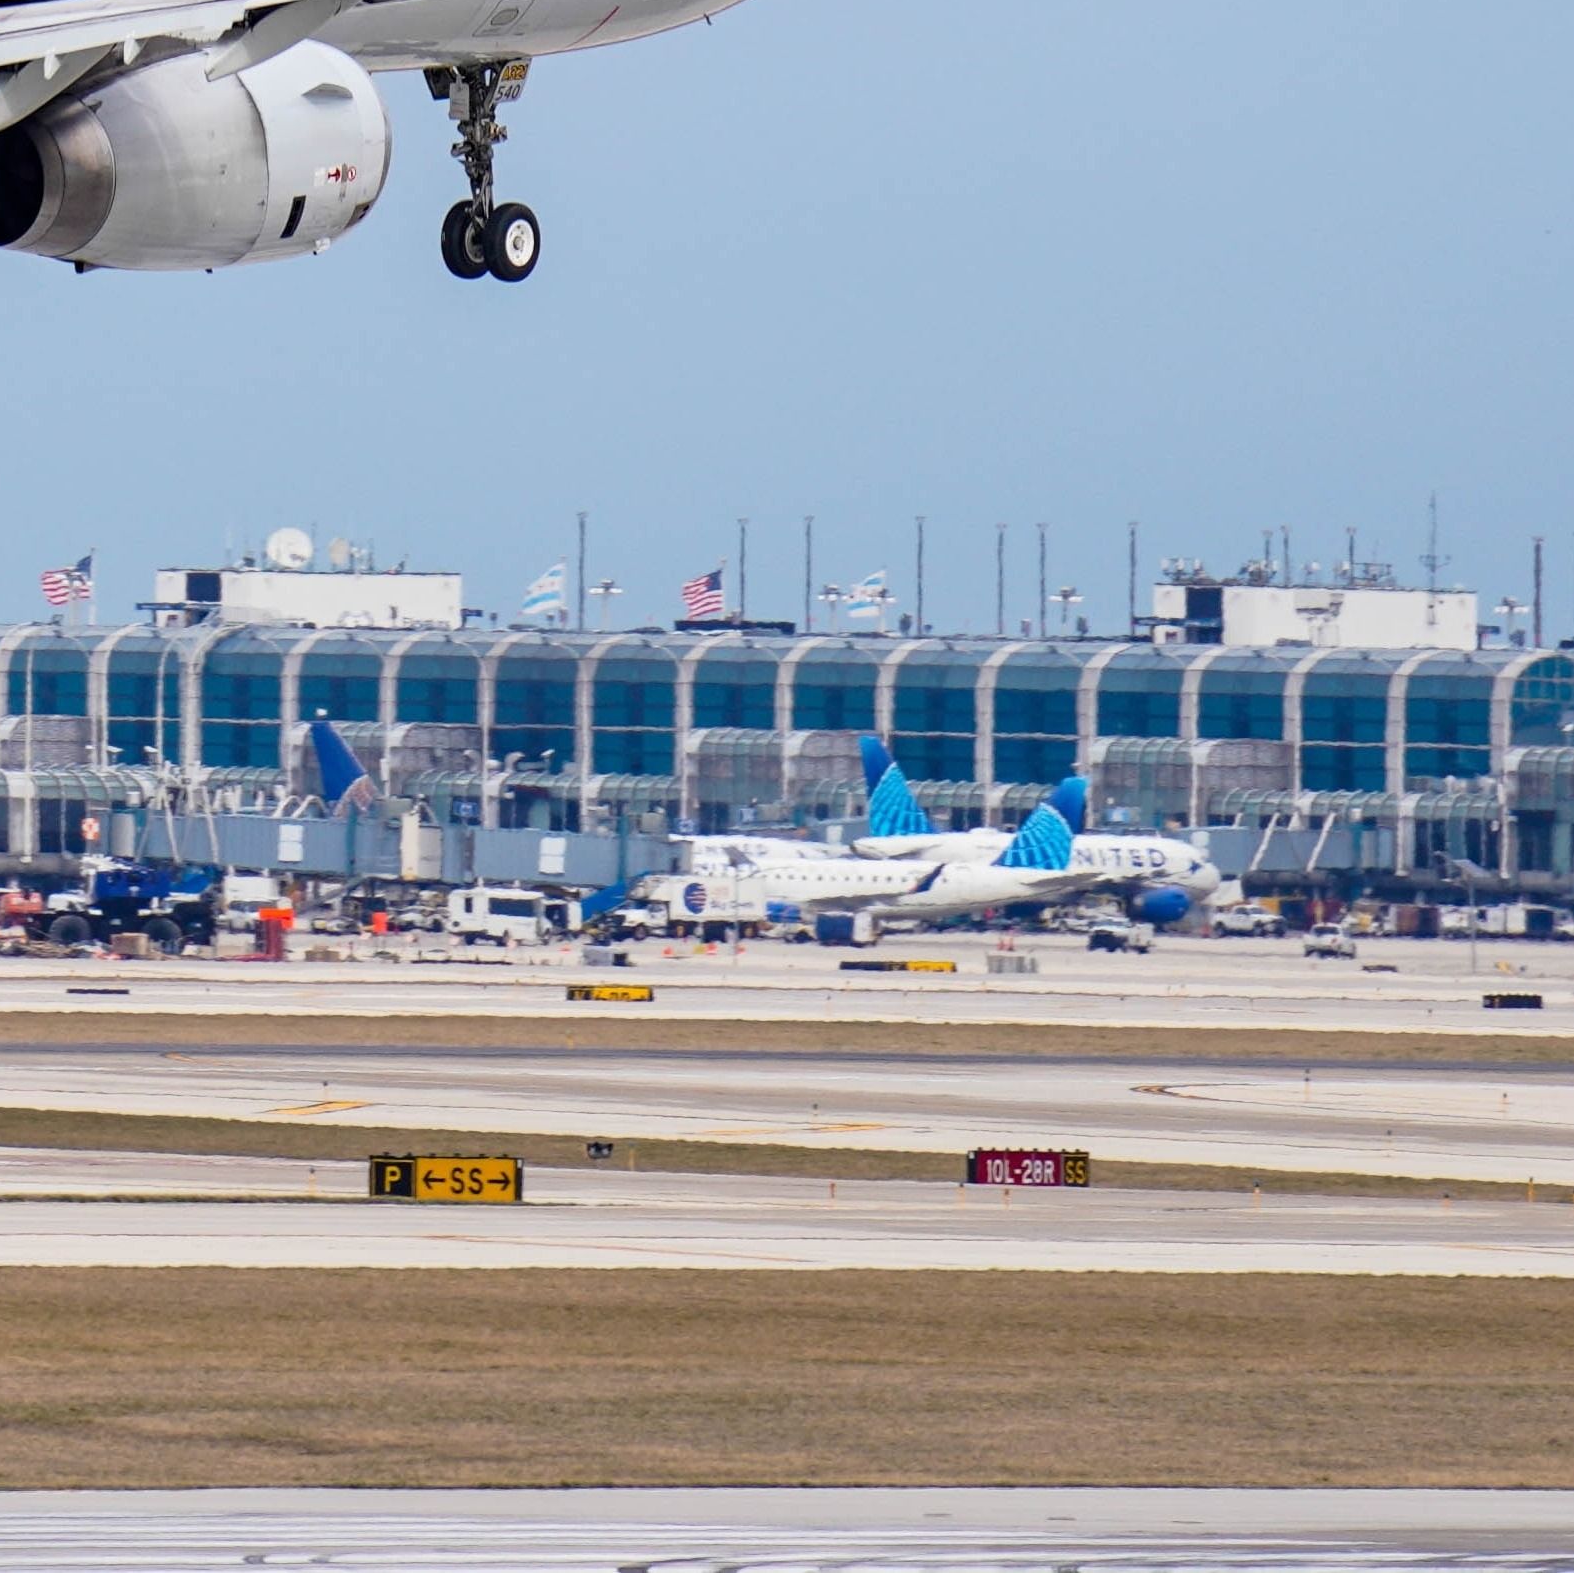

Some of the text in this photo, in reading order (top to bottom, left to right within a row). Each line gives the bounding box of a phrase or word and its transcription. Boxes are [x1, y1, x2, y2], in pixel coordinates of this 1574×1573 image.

[494, 84, 521, 101] 540
[1074, 848, 1167, 868] NITED
[384, 1166, 484, 1195] P SS
[986, 1158, 1087, 1185] 10L-28R SS
